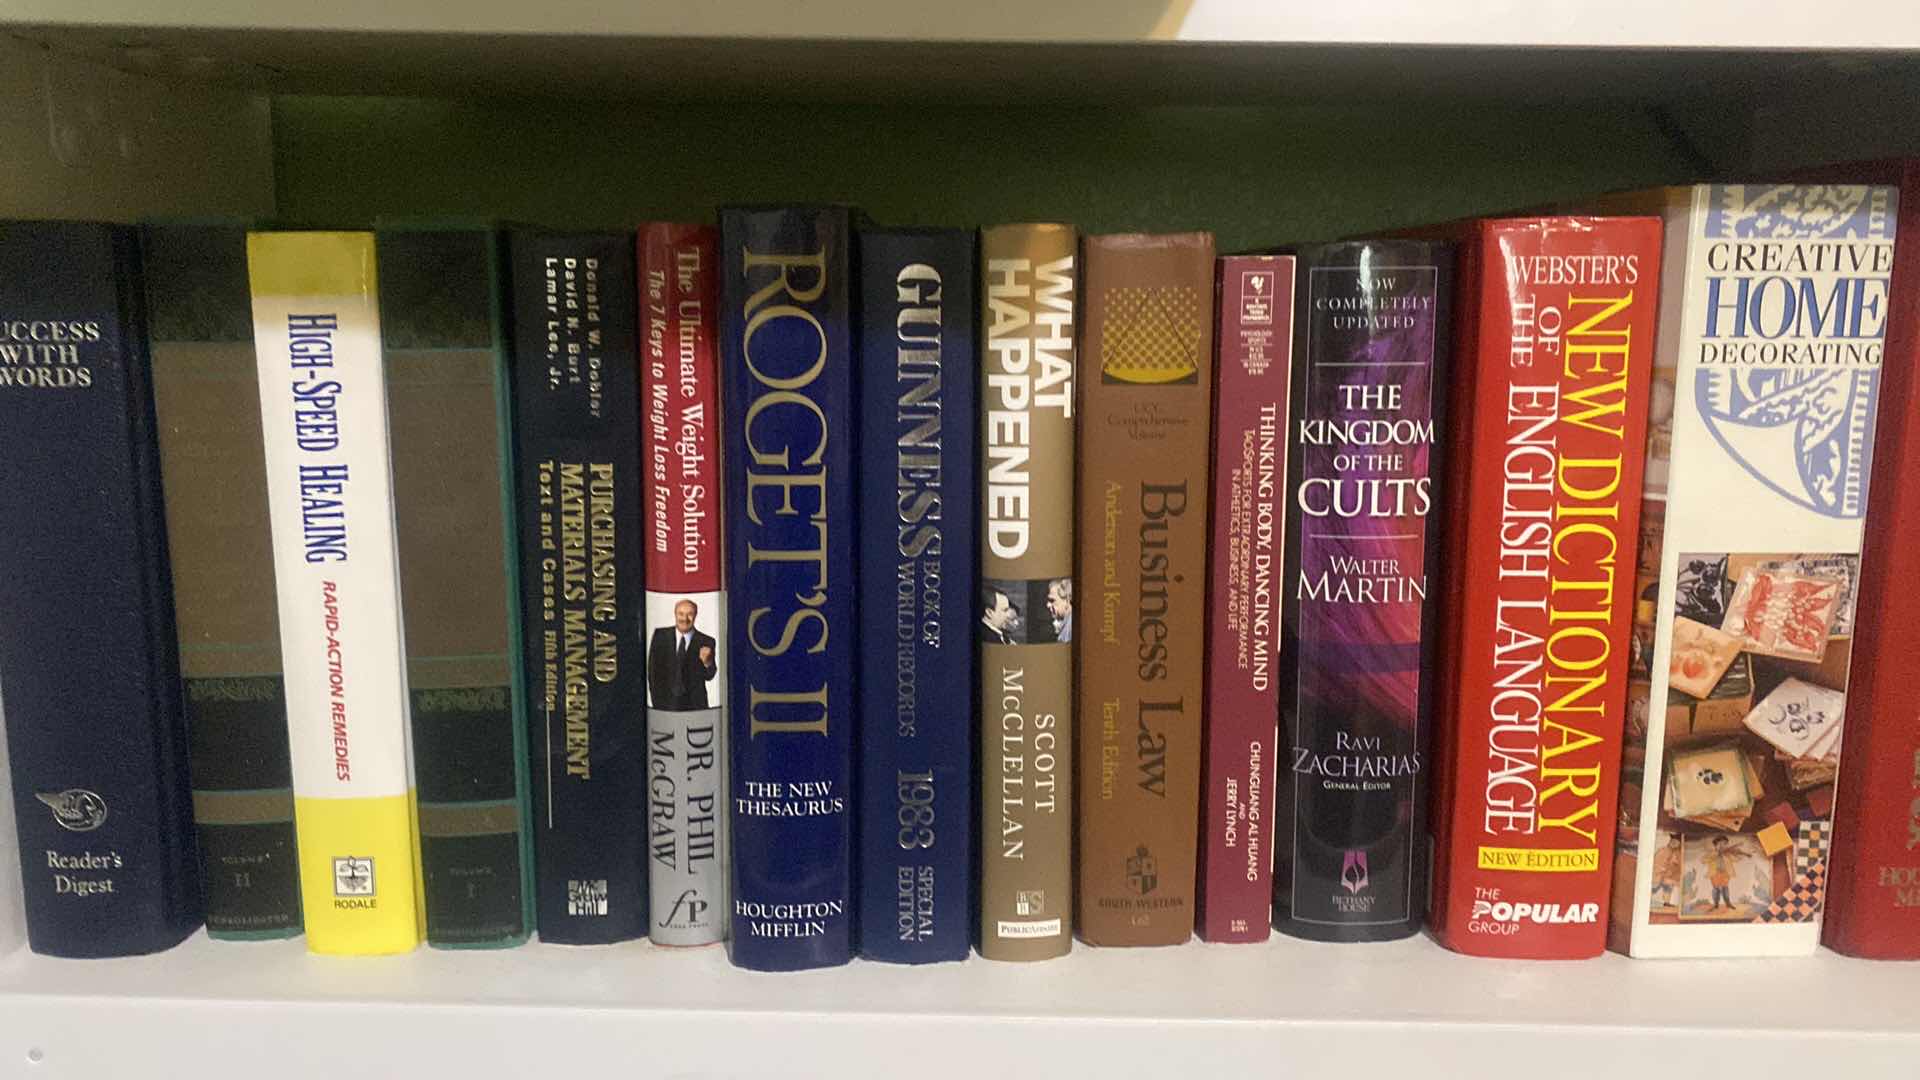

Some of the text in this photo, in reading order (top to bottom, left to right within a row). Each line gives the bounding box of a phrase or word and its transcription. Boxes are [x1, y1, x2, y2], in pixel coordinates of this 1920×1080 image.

[1511, 255, 1639, 285] WEBSTER'S
[1707, 243, 1893, 273] CREATIVE
[564, 258, 578, 309] David
[585, 258, 600, 321] Donald
[1316, 297, 1431, 311] COMPLETELY
[545, 258, 563, 390] Lamar Lee, Jr.
[1333, 316, 1415, 329] UPDATED
[1701, 276, 1890, 340] HOME
[1034, 255, 1074, 419] WHAT
[1538, 306, 1561, 355] OF
[0, 344, 79, 365] WITH
[567, 343, 582, 383] Burt
[1700, 342, 1882, 366] DECORATING
[649, 270, 672, 552] The 7 Keys to Weight Loss Freedom
[675, 247, 706, 573] The Ultimate Weight Solution
[897, 263, 942, 557] GUINNESS
[988, 258, 1031, 559] HAPPENED
[1339, 384, 1402, 411] THE
[287, 314, 349, 563] HIGH-SPEED HEALING
[1300, 418, 1435, 445] KINGDOM
[1333, 454, 1403, 472] OF THE
[743, 244, 829, 742] ROGET'S II
[1241, 489, 1252, 509] FOR
[1298, 477, 1431, 517] CULTS
[540, 512, 556, 549] and
[1253, 402, 1276, 691] THINKING BODY, DANCING MIND
[590, 463, 619, 682] PURCHASING AND
[1297, 568, 1427, 604] MARTIN
[1330, 555, 1400, 576] WALTER
[1484, 294, 1560, 836] THE ENGLISH LANGUAGE
[1538, 289, 1633, 845] NEW DICTIONARY
[542, 558, 557, 621] Cases
[922, 560, 941, 648] BOOK OF
[560, 463, 591, 780] MATERIALS MANAGEMENT
[1137, 479, 1187, 799] Business Law
[1238, 595, 1249, 670] PERFORMANCE
[897, 561, 916, 737] WORLD RECORDS
[323, 580, 351, 782] RAPID-ACTION REMEDIES
[1336, 731, 1380, 751] RAVI
[1035, 714, 1055, 813] SCOTT
[1292, 747, 1421, 778] ZACHARIAS
[651, 728, 677, 872] McGRAW
[686, 724, 715, 875] DR. PHIL
[745, 780, 832, 798] THE NEW
[1323, 780, 1391, 791] GENERAL EDITOR
[736, 798, 844, 817] THESAURUS
[1226, 777, 1238, 847] JERRY LYNCH
[46, 850, 123, 869] Reader's
[1247, 839, 1259, 881] HUANG
[1482, 849, 1597, 868] NEW EDITION
[54, 874, 114, 897] Digest
[334, 899, 377, 910] RODALE
[898, 865, 915, 941] EDITION
[918, 866, 935, 943] SPECIAL
[1475, 887, 1501, 900] THE
[736, 900, 843, 919] HOUGHTON
[751, 921, 825, 937] MIFFLIN
[1468, 921, 1520, 936] GROUP
[1472, 901, 1600, 924] POPULAR
